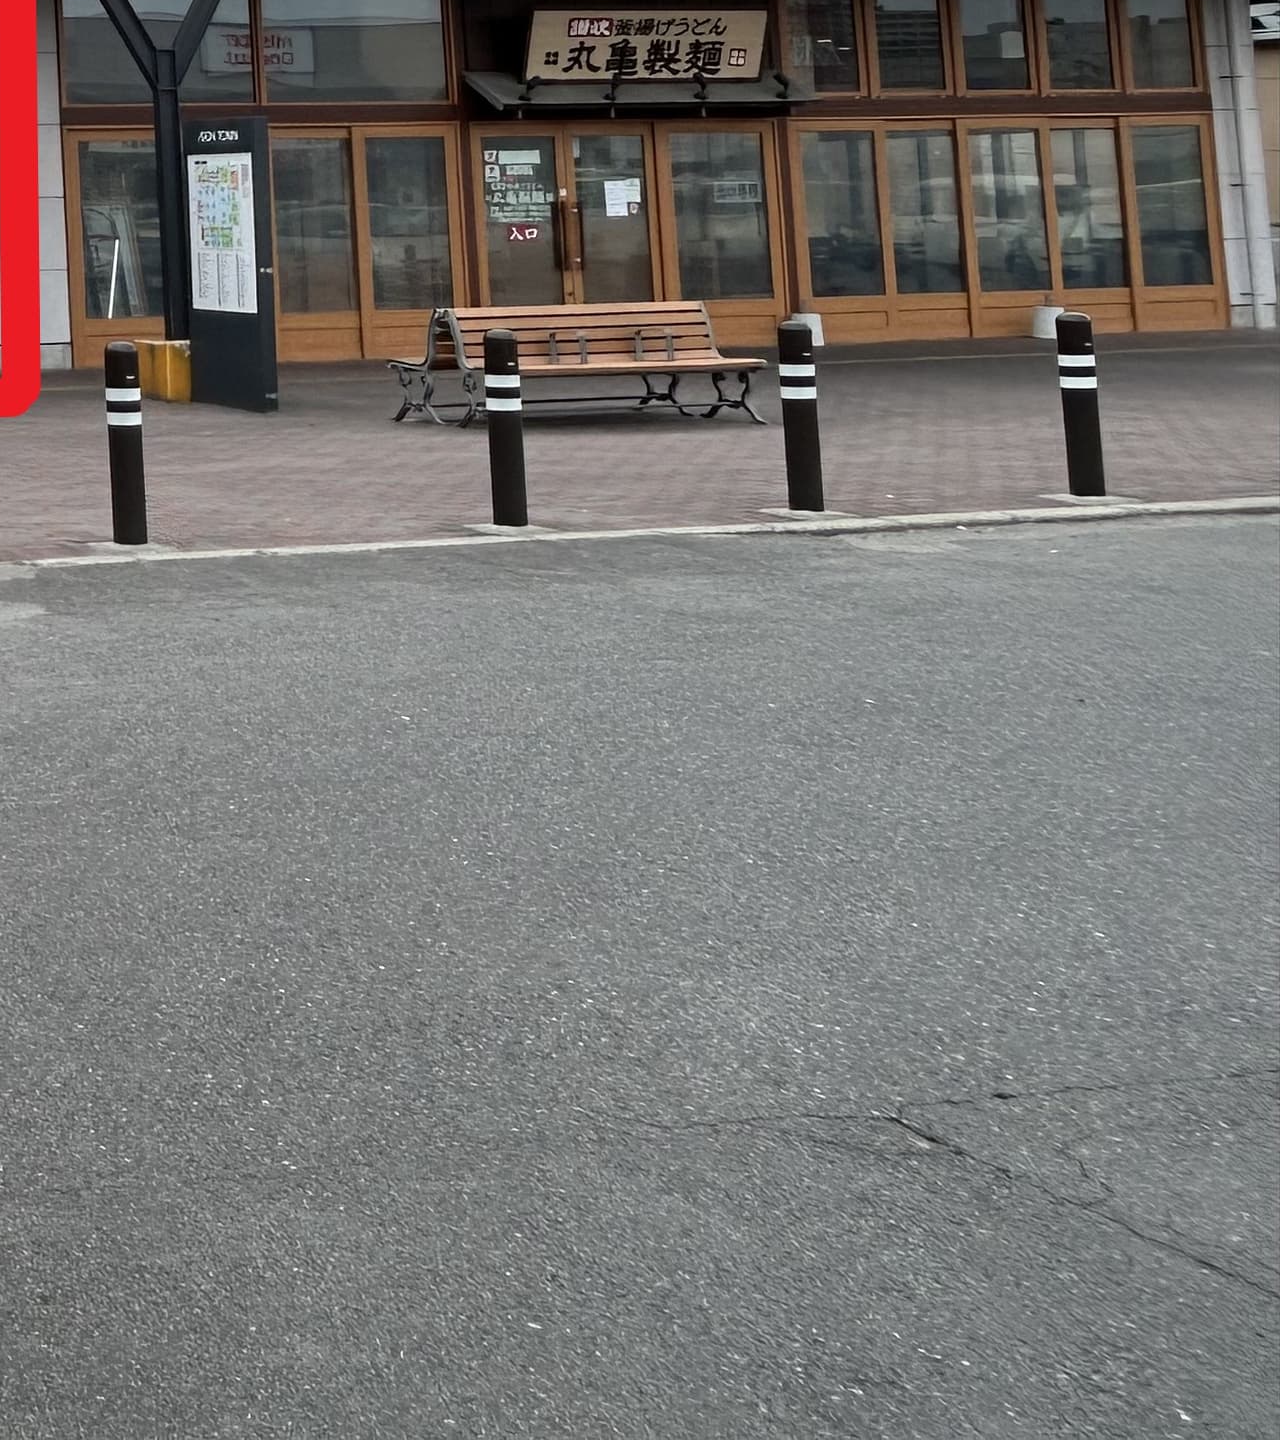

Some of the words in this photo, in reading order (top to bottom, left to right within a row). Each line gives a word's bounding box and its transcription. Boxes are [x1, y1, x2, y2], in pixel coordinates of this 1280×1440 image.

[561, 38, 726, 77] 丸亀製麺
[509, 227, 538, 241] 入口
